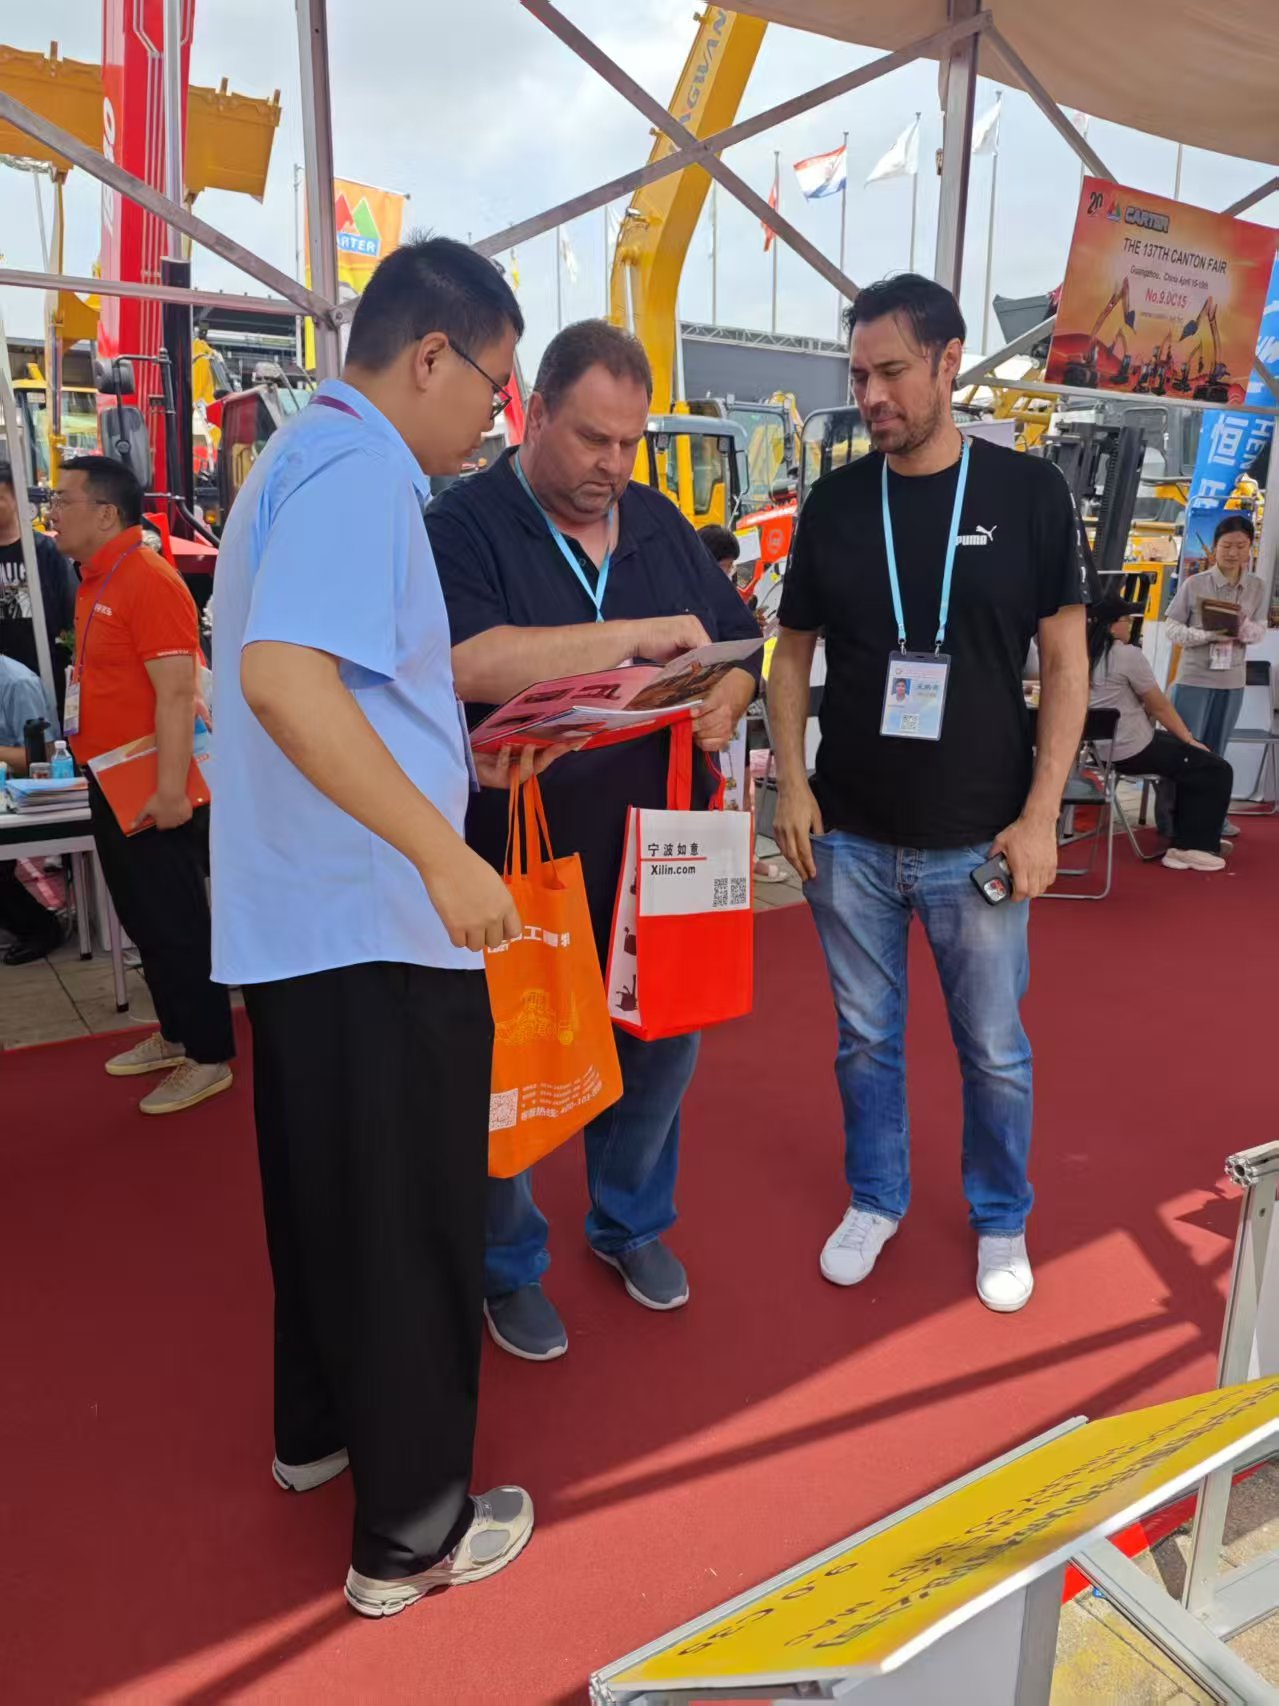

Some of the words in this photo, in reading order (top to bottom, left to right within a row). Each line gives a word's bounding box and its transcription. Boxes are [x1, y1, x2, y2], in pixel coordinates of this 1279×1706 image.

[1124, 206, 1170, 233] CARTER
[1124, 237, 1142, 255] THE
[1143, 242, 1170, 260] 137TH
[1170, 249, 1206, 270] CANTON
[1206, 258, 1227, 274] FAIR
[955, 534, 988, 546] PUMA
[647, 842, 699, 857] 宁波如意
[650, 864, 696, 875] Xilin.com
